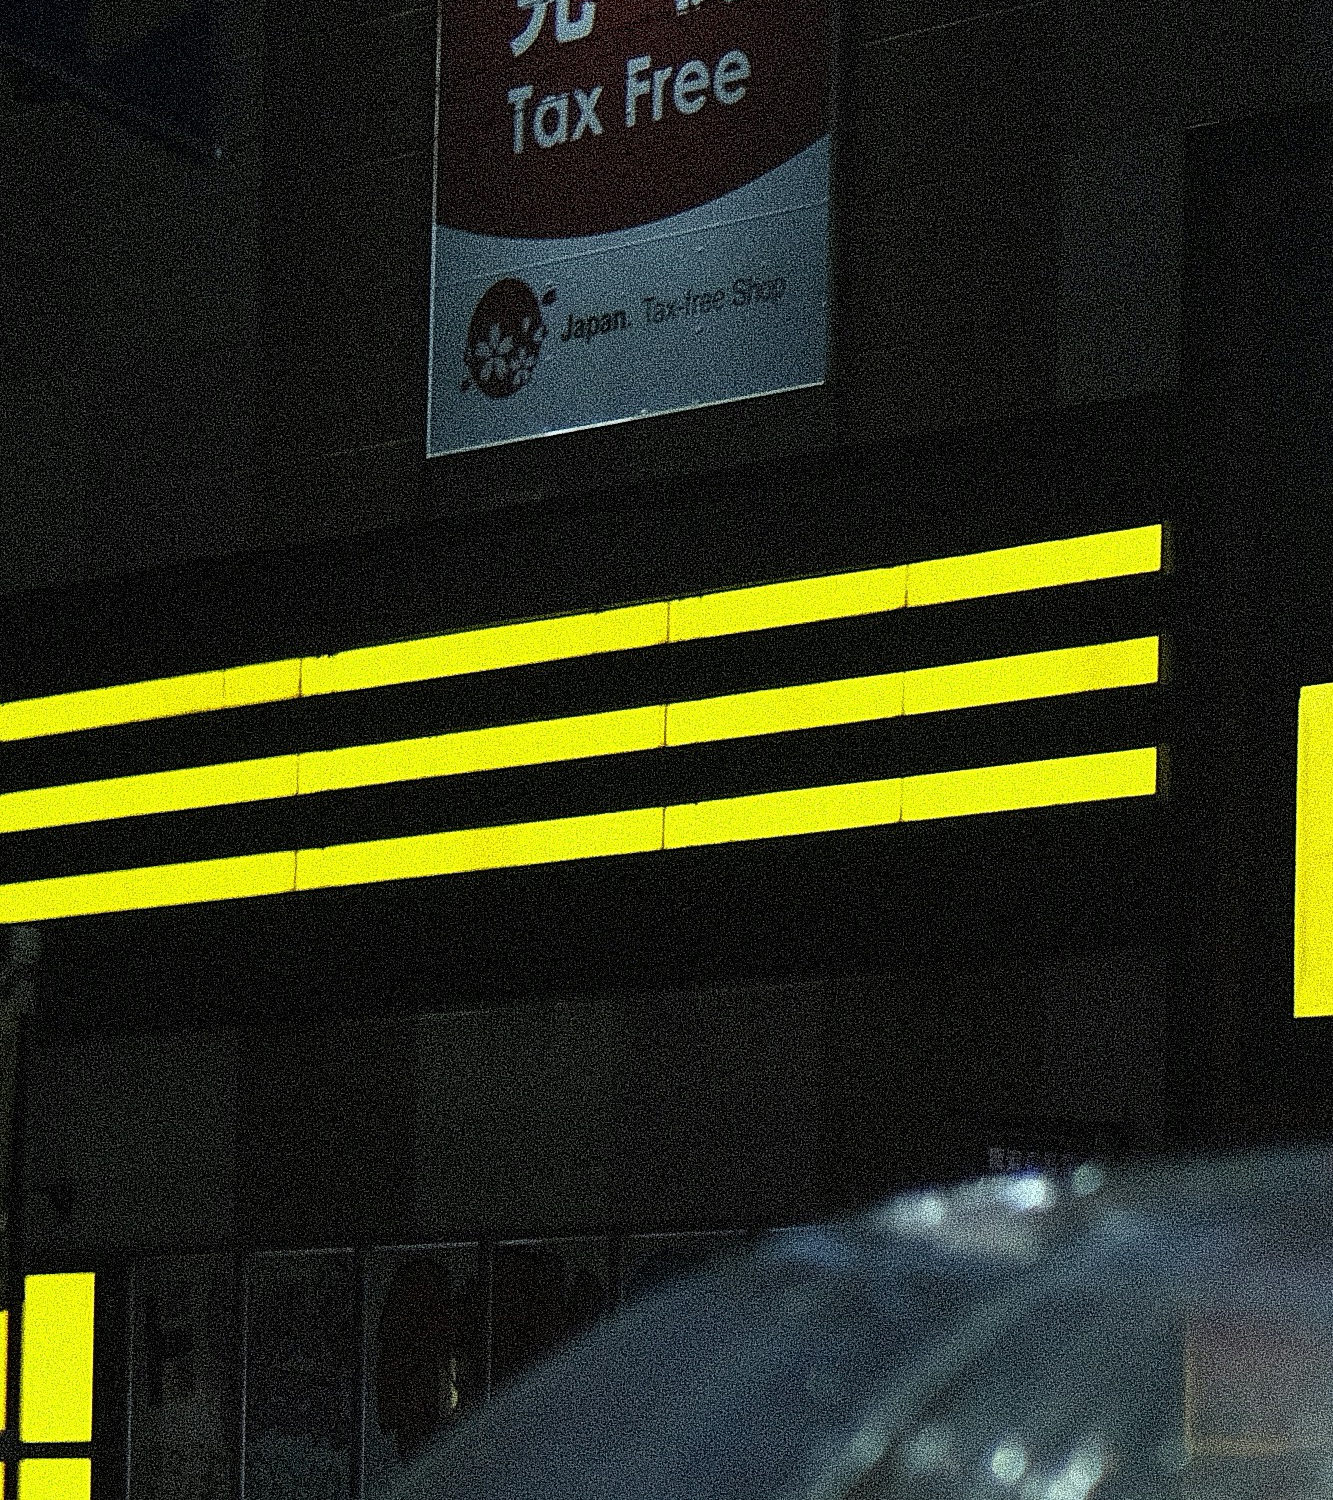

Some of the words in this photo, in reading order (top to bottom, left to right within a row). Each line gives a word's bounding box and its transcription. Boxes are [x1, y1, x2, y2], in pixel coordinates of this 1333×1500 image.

[507, 84, 604, 154] Tax
[624, 49, 752, 128] Free
[732, 275, 787, 307] Shop
